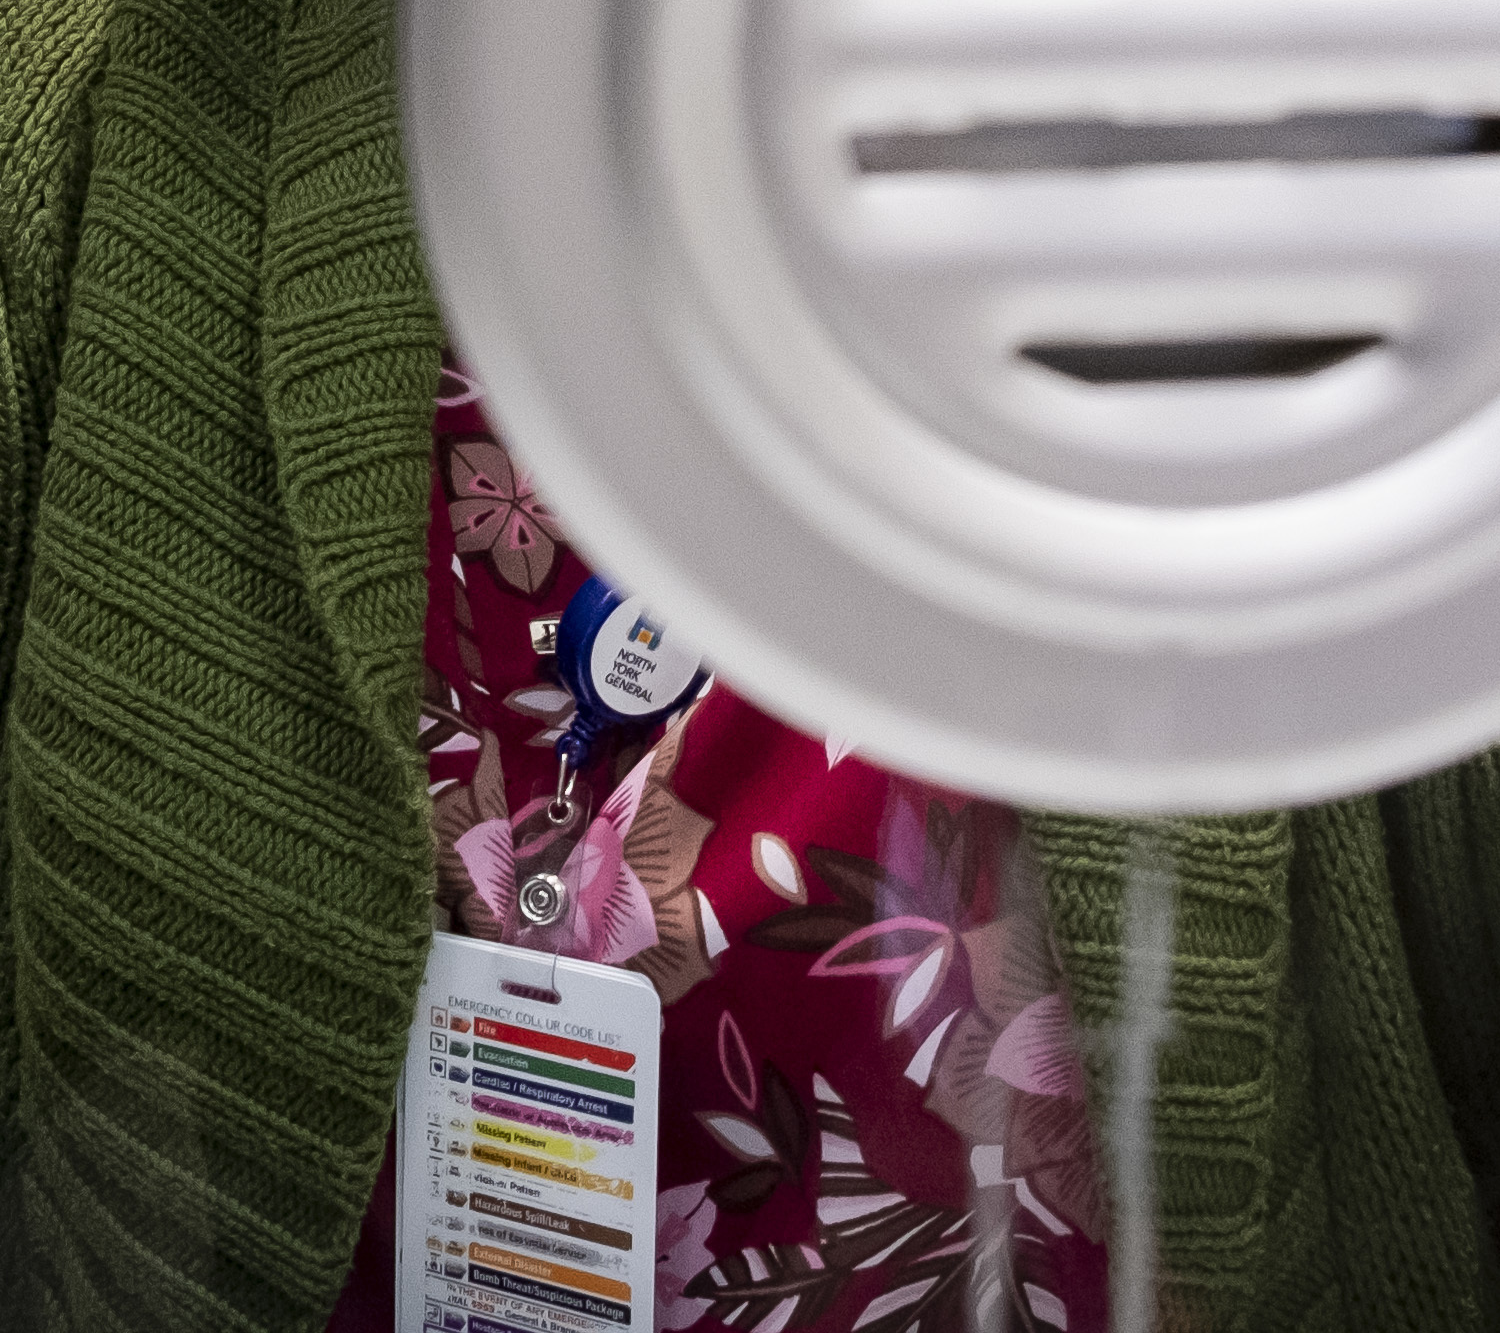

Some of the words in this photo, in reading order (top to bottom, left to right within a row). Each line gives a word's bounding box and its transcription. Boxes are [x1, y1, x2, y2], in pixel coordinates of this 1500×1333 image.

[612, 660, 641, 682] YORK
[616, 647, 657, 673] NORTH
[605, 672, 652, 703] GENERAL
[449, 996, 512, 1022] EMERGENCY
[564, 1023, 593, 1041] CODE
[478, 1021, 497, 1036] Fire
[478, 1047, 529, 1070] Evacuation
[474, 1072, 511, 1091] Cardiac
[519, 1084, 576, 1108] Respiratory
[578, 1096, 608, 1115] Arrest
[476, 1121, 511, 1143] Missing
[473, 1147, 511, 1168] Missing
[514, 1157, 542, 1174] Infant
[475, 1197, 523, 1220] Hazardous
[525, 1209, 571, 1232] Spill/Leak
[474, 1247, 512, 1268] External
[514, 1258, 551, 1277] Disaster
[458, 1285, 476, 1299] THE
[478, 1290, 508, 1307] EVENT
[511, 1300, 524, 1310] OF
[474, 1269, 499, 1287] Bomb
[502, 1276, 583, 1308] Threat/Suspicious
[585, 1300, 624, 1320] Package
